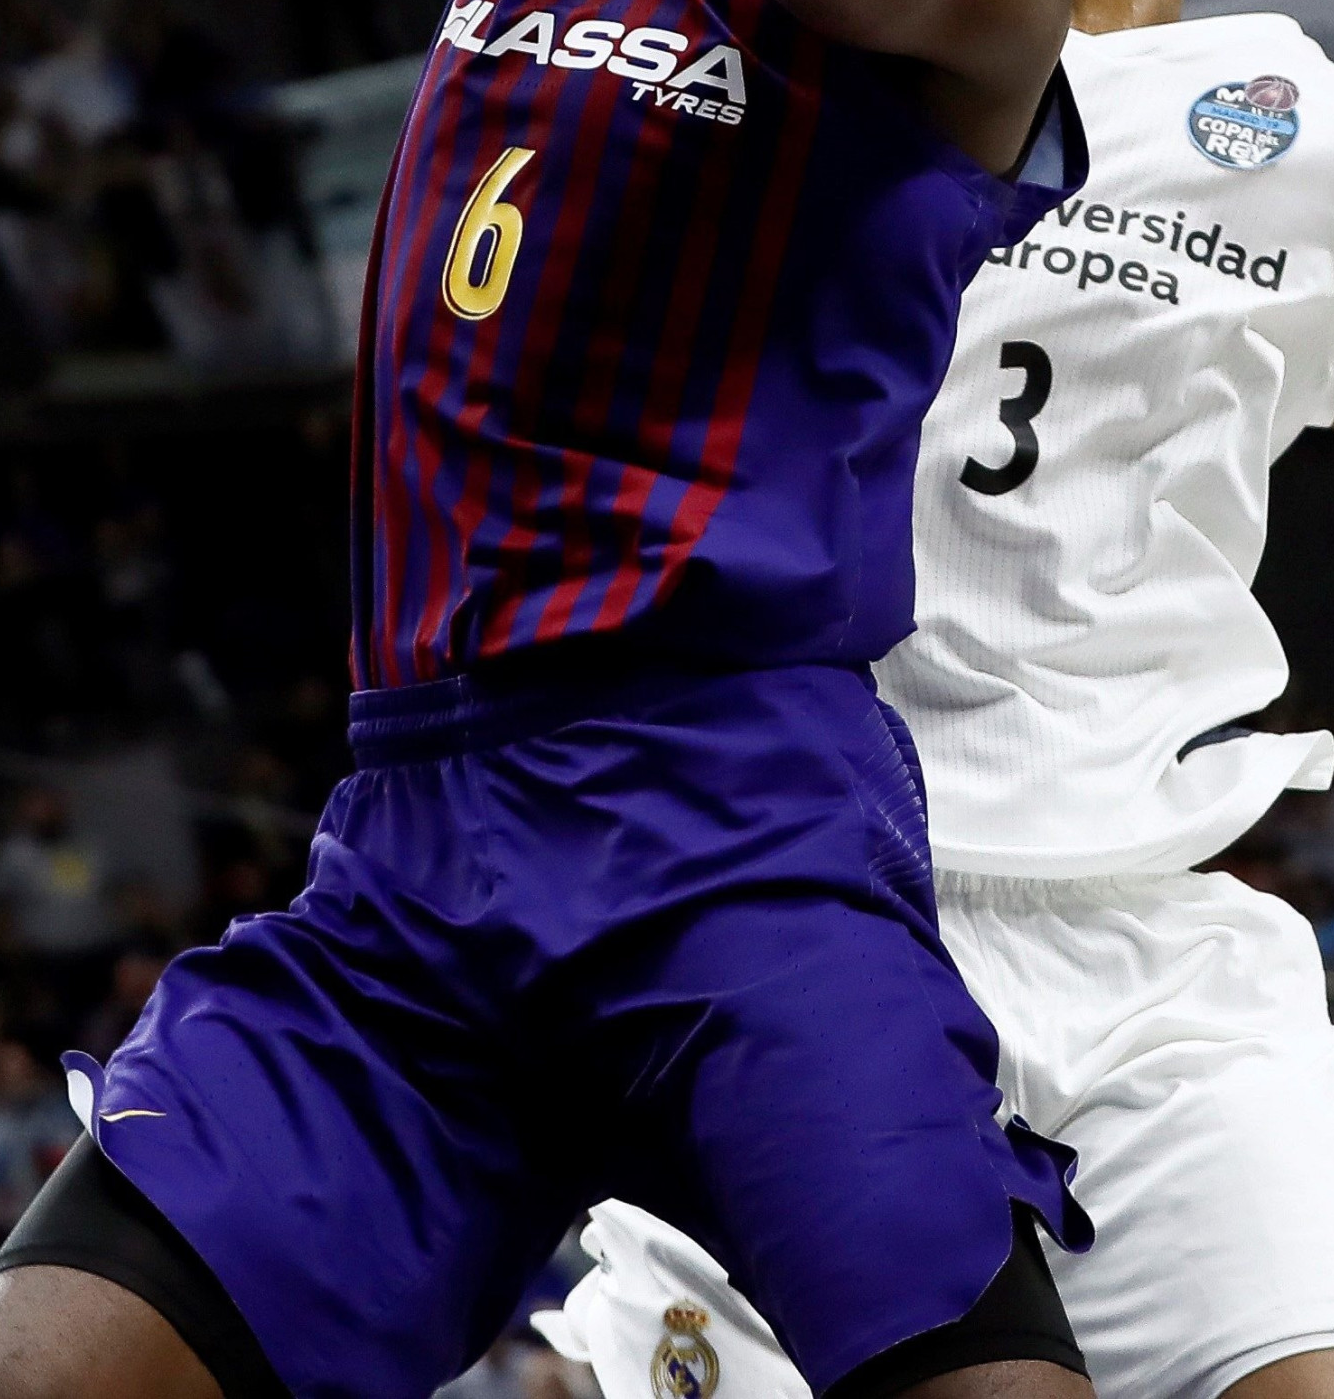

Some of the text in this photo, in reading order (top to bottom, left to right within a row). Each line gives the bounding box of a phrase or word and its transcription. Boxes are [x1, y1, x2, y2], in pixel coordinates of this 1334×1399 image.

[453, 0, 747, 105] LASSA
[631, 81, 746, 126] TYRES
[1197, 116, 1255, 144] COPA
[1205, 133, 1272, 164] REY
[441, 145, 537, 322] 6
[985, 239, 1179, 306] uropea
[1053, 198, 1288, 292] versidad
[959, 340, 1053, 496] 3
